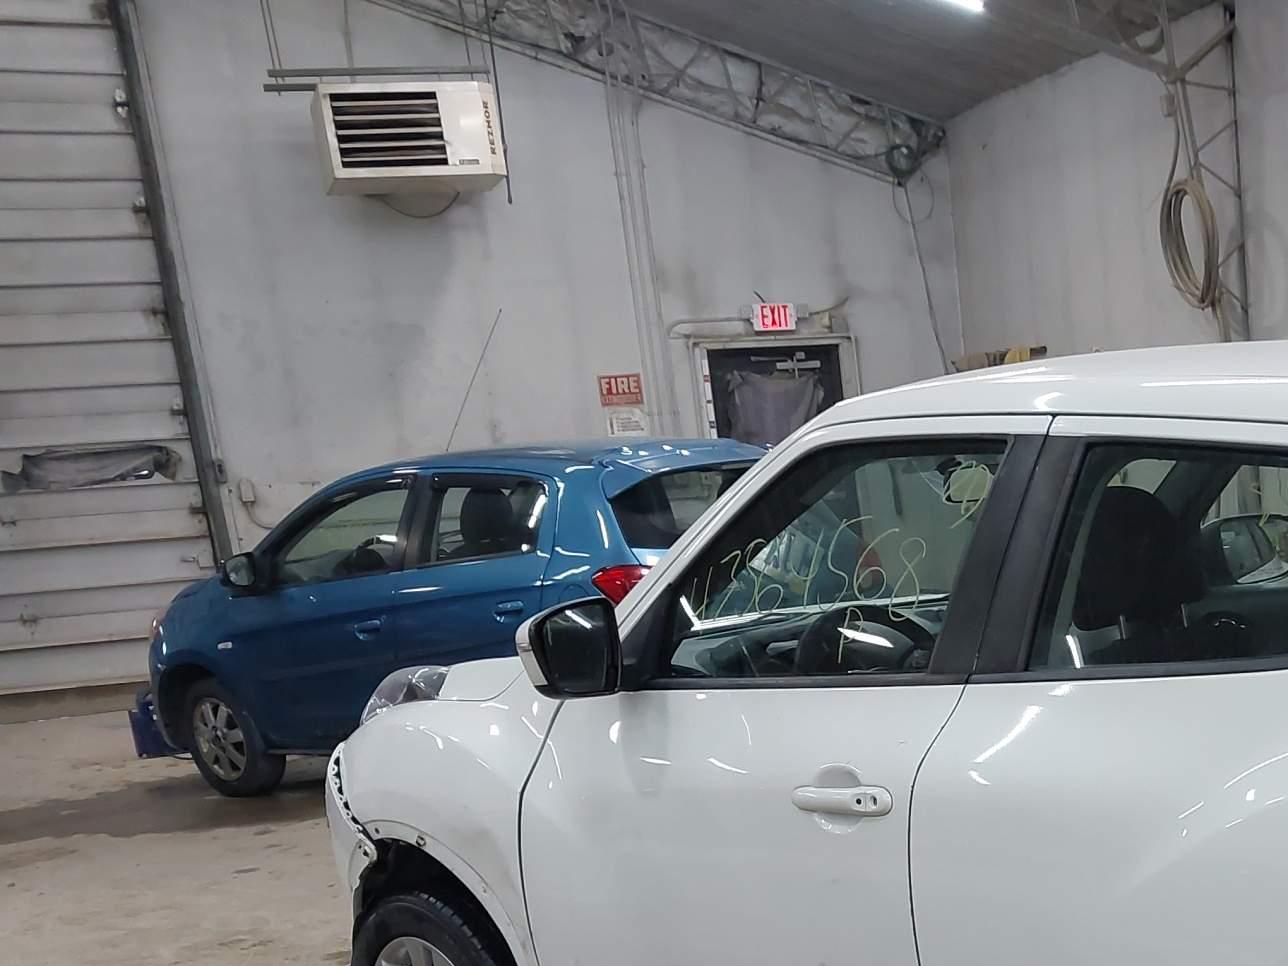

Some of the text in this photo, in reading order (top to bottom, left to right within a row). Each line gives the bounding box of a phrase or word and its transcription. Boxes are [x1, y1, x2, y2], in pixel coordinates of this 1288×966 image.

[482, 101, 497, 155] REZNOR
[760, 304, 789, 329] EXIT
[600, 376, 640, 395] FIRE
